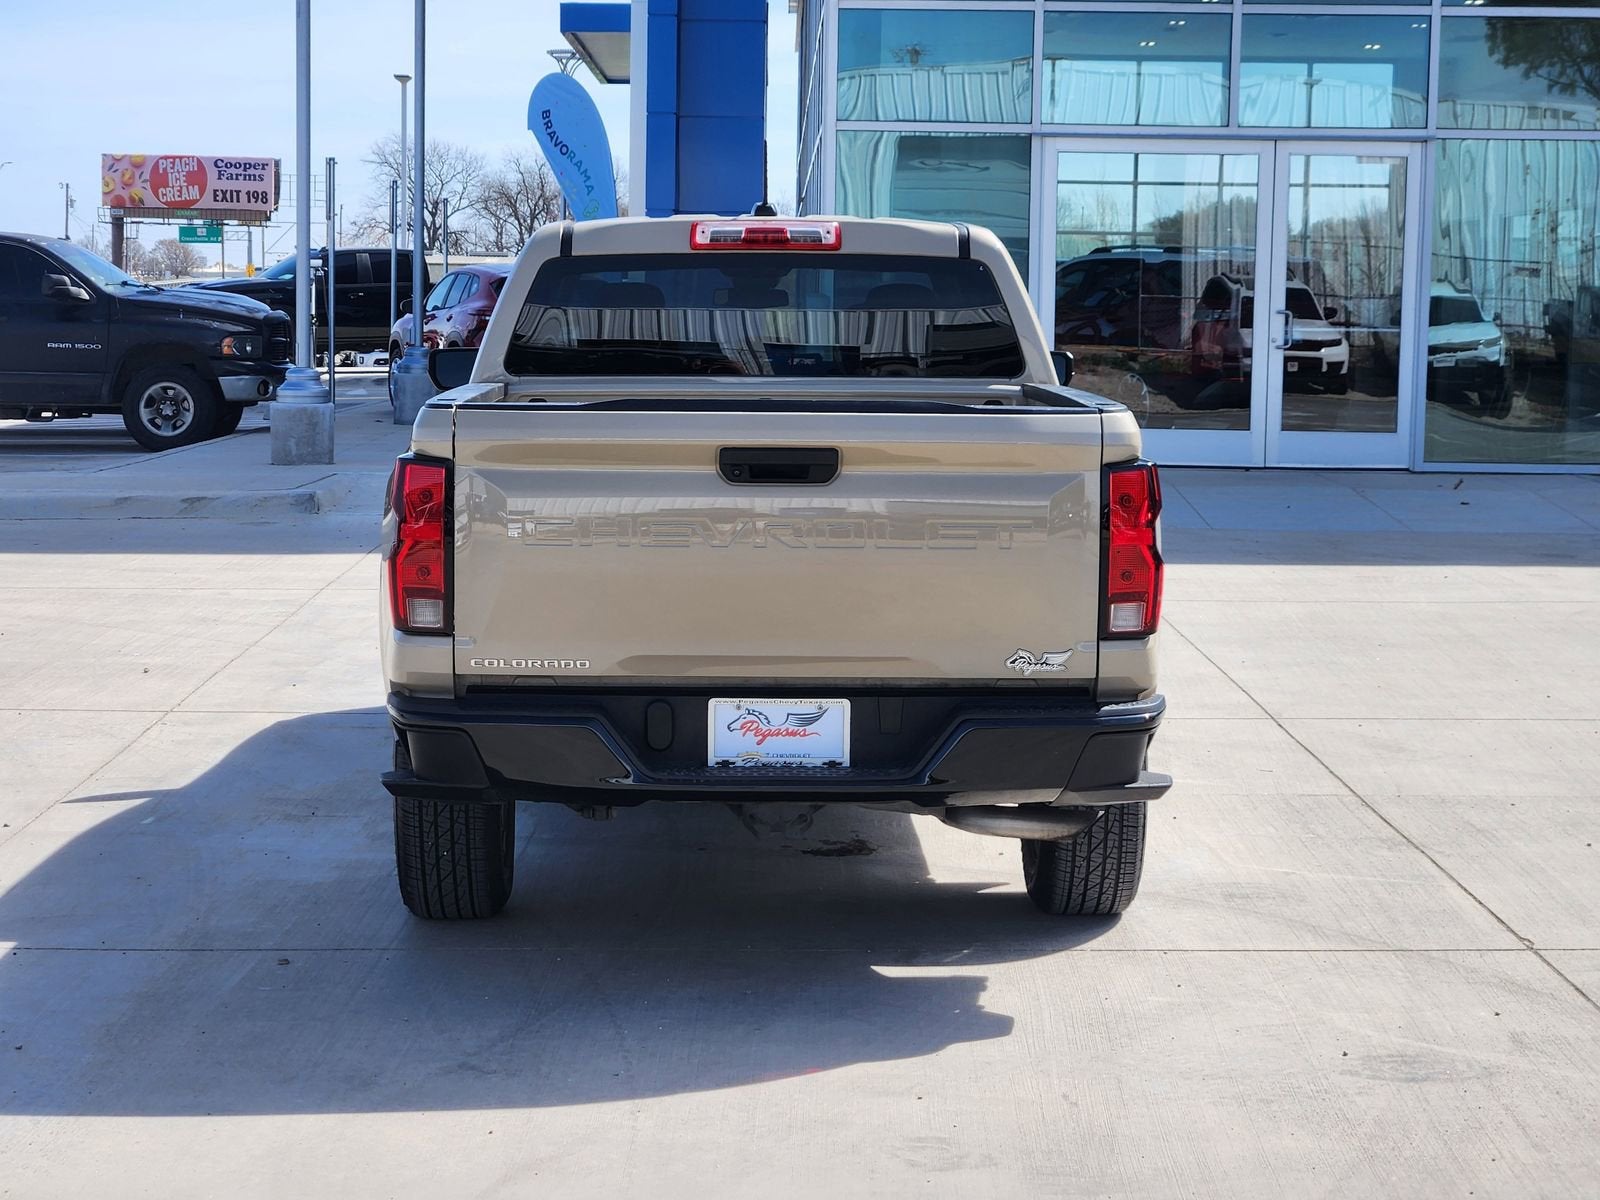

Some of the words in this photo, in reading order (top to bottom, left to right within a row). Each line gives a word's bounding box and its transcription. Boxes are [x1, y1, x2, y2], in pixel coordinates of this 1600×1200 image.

[541, 108, 595, 196] BRAVORAMA
[158, 156, 198, 173] PEACH
[213, 158, 269, 172] Cooper
[168, 171, 187, 186] ICE
[216, 170, 265, 182] Farms
[158, 185, 200, 202] CREAM
[212, 189, 242, 204] EXIT
[245, 190, 269, 205] 198
[521, 516, 1034, 549] CHEVROLET
[470, 658, 590, 669] COLORADO
[1013, 657, 1068, 677] Pegasus
[739, 719, 822, 746] Pegasus
